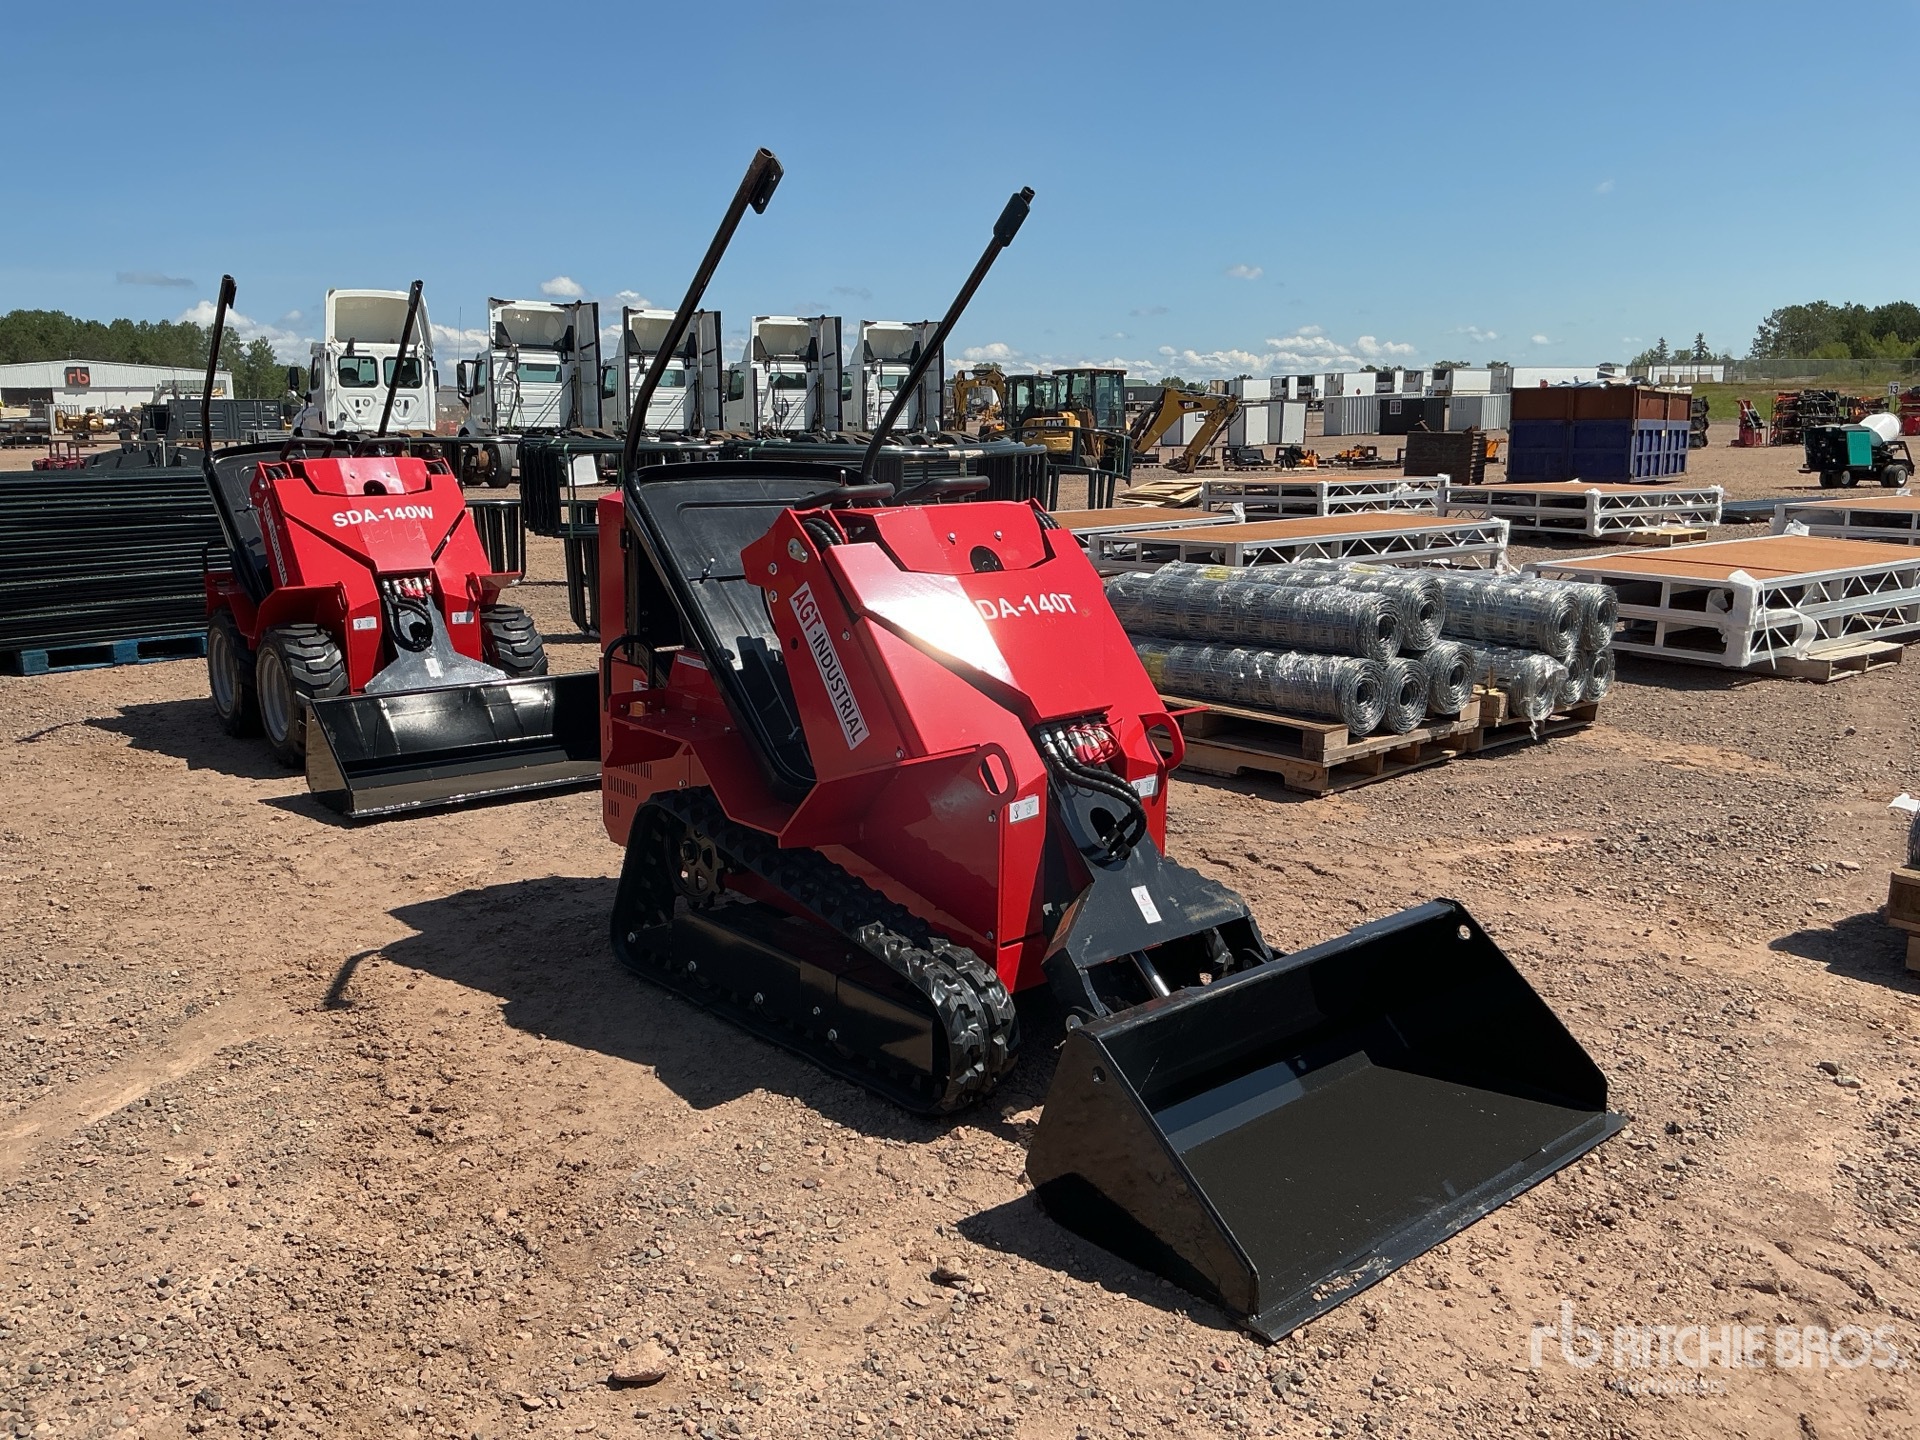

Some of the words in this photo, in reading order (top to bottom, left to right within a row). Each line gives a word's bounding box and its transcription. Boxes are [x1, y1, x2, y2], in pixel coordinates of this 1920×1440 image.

[67, 368, 90, 385] rb
[1890, 385, 1899, 394] 13
[332, 505, 434, 528] SDA-140W
[973, 592, 1077, 620] DA-140T
[793, 589, 821, 632] AGT
[813, 632, 864, 743] INDUSTRIAL
